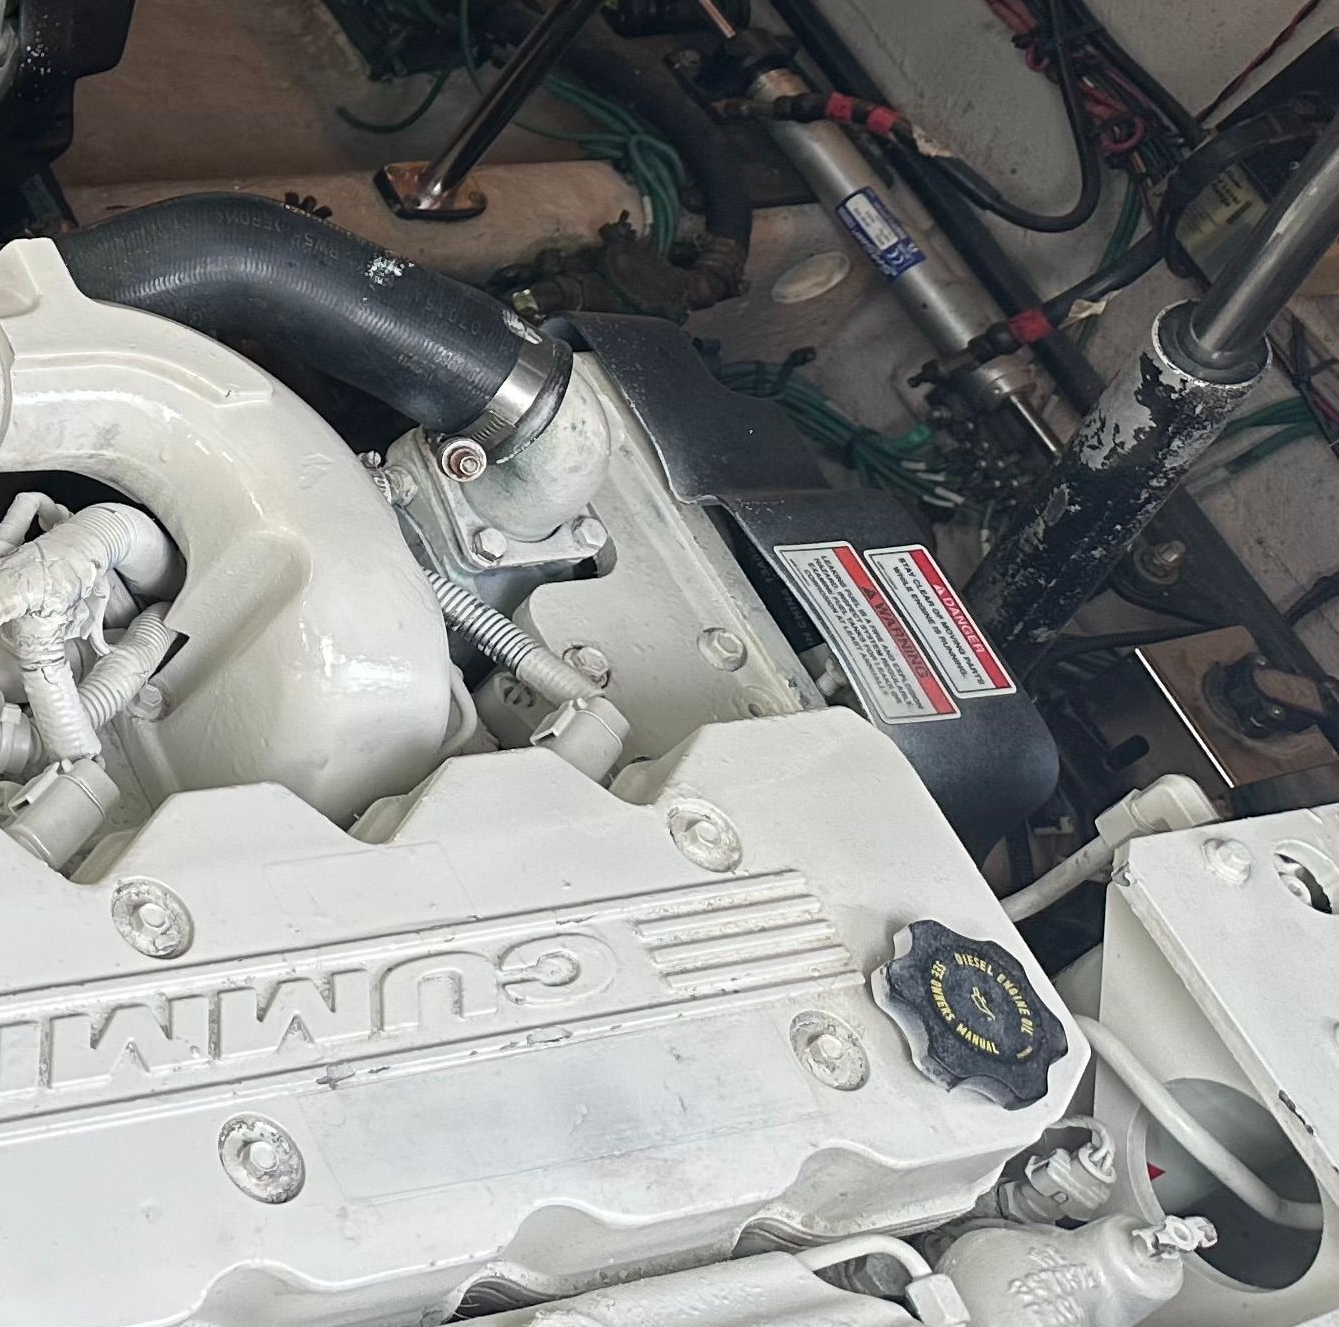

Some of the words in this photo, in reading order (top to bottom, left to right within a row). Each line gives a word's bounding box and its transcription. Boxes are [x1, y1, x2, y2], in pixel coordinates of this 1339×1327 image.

[819, 555, 847, 587] LEAKING
[891, 567, 914, 591] WHILE
[909, 594, 935, 624] ENGINE
[931, 626, 942, 634] IS
[897, 558, 916, 577] STAY
[911, 578, 935, 606] CLEAR
[930, 607, 944, 619] OF
[939, 621, 966, 654] MOVING
[961, 656, 986, 684] PARTS
[942, 596, 986, 654] DANGER
[873, 601, 930, 678] WARNING
[930, 960, 947, 980] SEE
[954, 952, 993, 977] DIESEL
[996, 974, 1031, 1016] ENGINE
[1020, 1014, 1033, 1036] OIL
[930, 979, 956, 1021] OWNERS
[956, 1023, 1000, 1055] MANUAL
